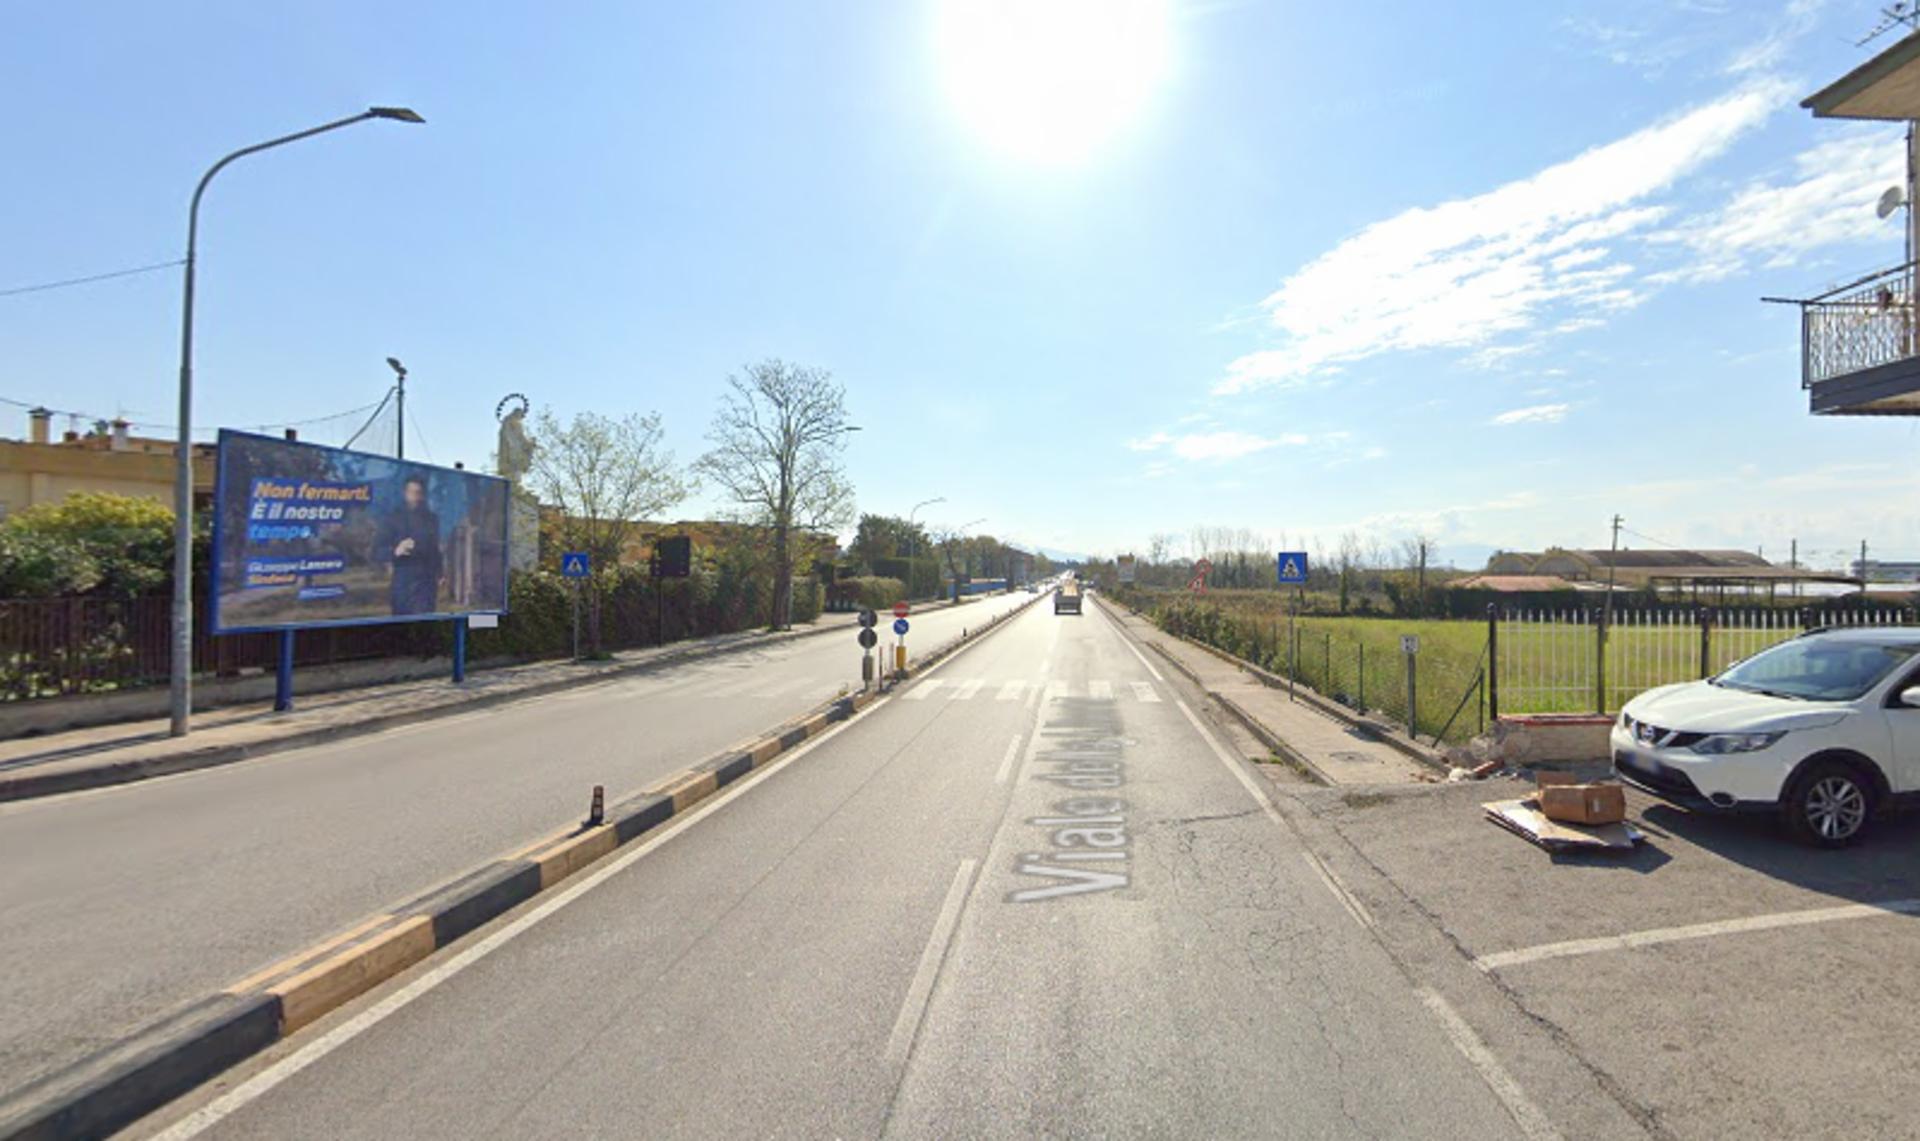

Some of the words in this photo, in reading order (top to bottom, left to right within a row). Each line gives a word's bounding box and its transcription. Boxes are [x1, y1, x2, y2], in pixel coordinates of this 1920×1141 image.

[254, 482, 294, 498] Non
[298, 483, 370, 500] fermarti.
[251, 499, 267, 519] È
[268, 502, 283, 519] il
[285, 506, 343, 519] nostro
